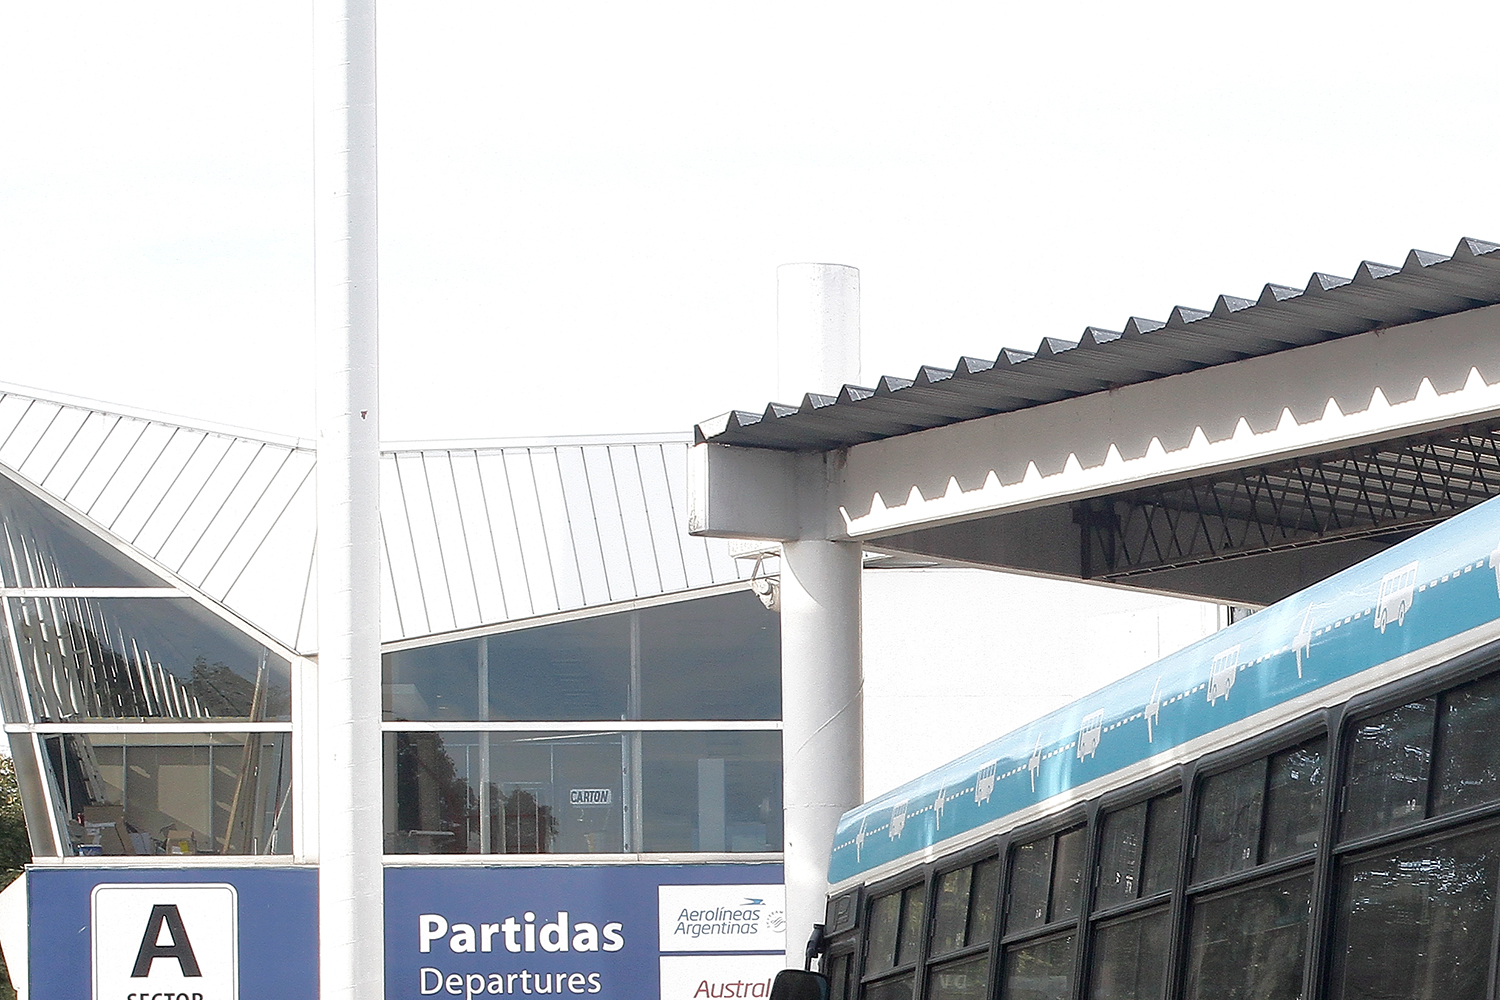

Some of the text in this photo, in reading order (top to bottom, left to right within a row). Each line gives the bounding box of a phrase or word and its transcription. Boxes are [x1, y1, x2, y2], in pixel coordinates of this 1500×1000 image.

[571, 790, 608, 802] CARTON
[677, 907, 761, 921] Aerolíneas
[419, 911, 625, 952] Partidas
[674, 921, 758, 938] Argentinas
[130, 904, 202, 977] A
[420, 967, 602, 1000] Departures
[693, 978, 771, 998] Austral
